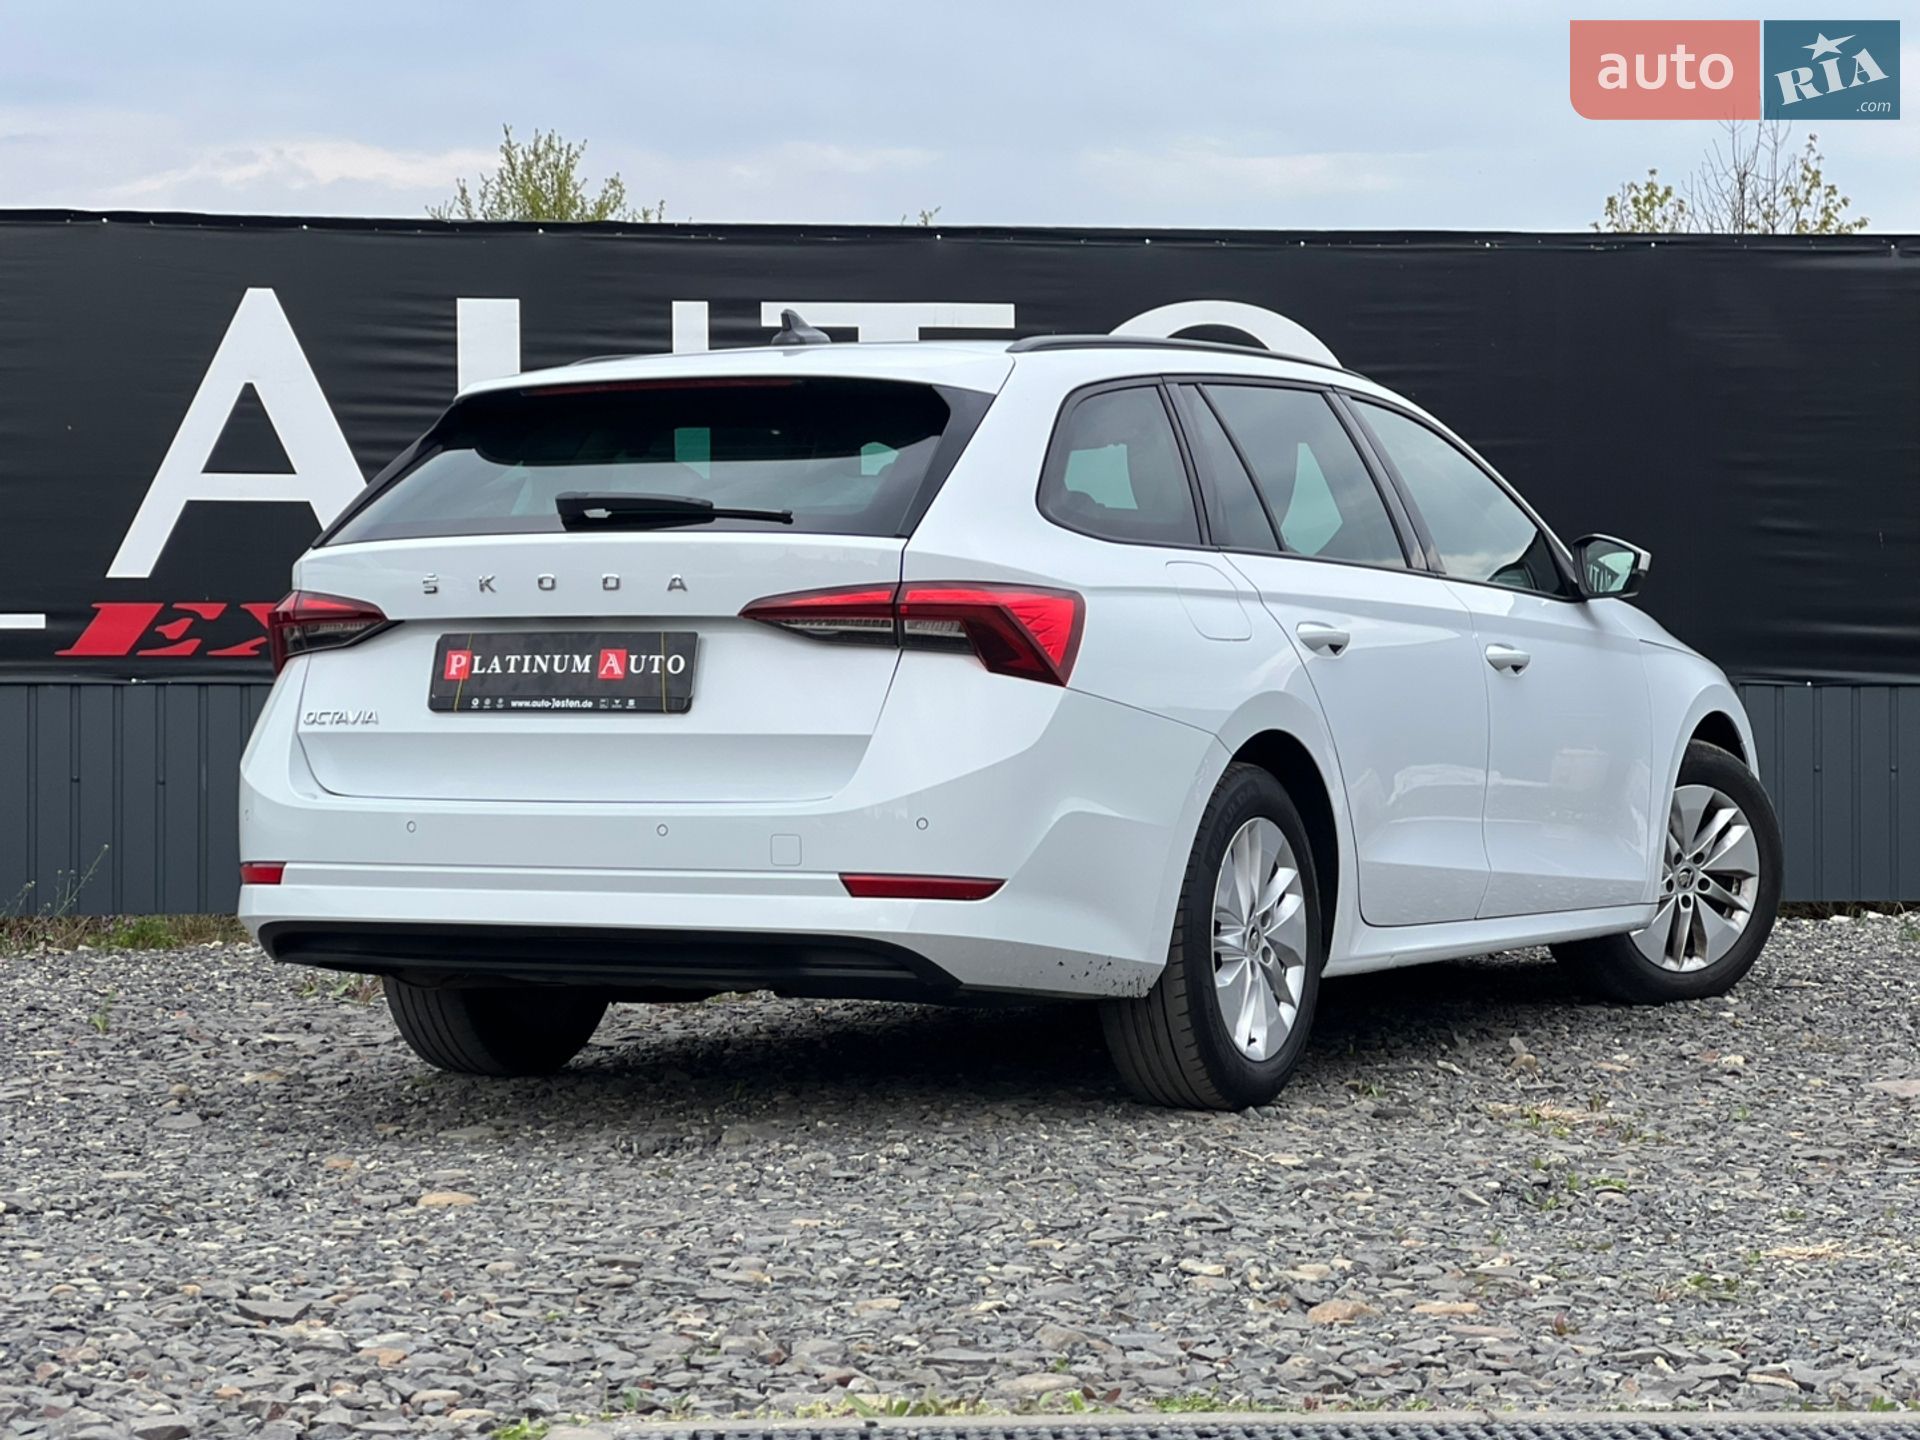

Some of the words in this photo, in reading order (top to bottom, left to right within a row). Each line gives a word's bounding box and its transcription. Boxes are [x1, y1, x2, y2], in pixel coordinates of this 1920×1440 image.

[422, 572, 688, 594] ŠKODA
[449, 652, 592, 676] PLATINUM
[600, 651, 686, 676] AUTO
[303, 710, 379, 725] OCTAVIA
